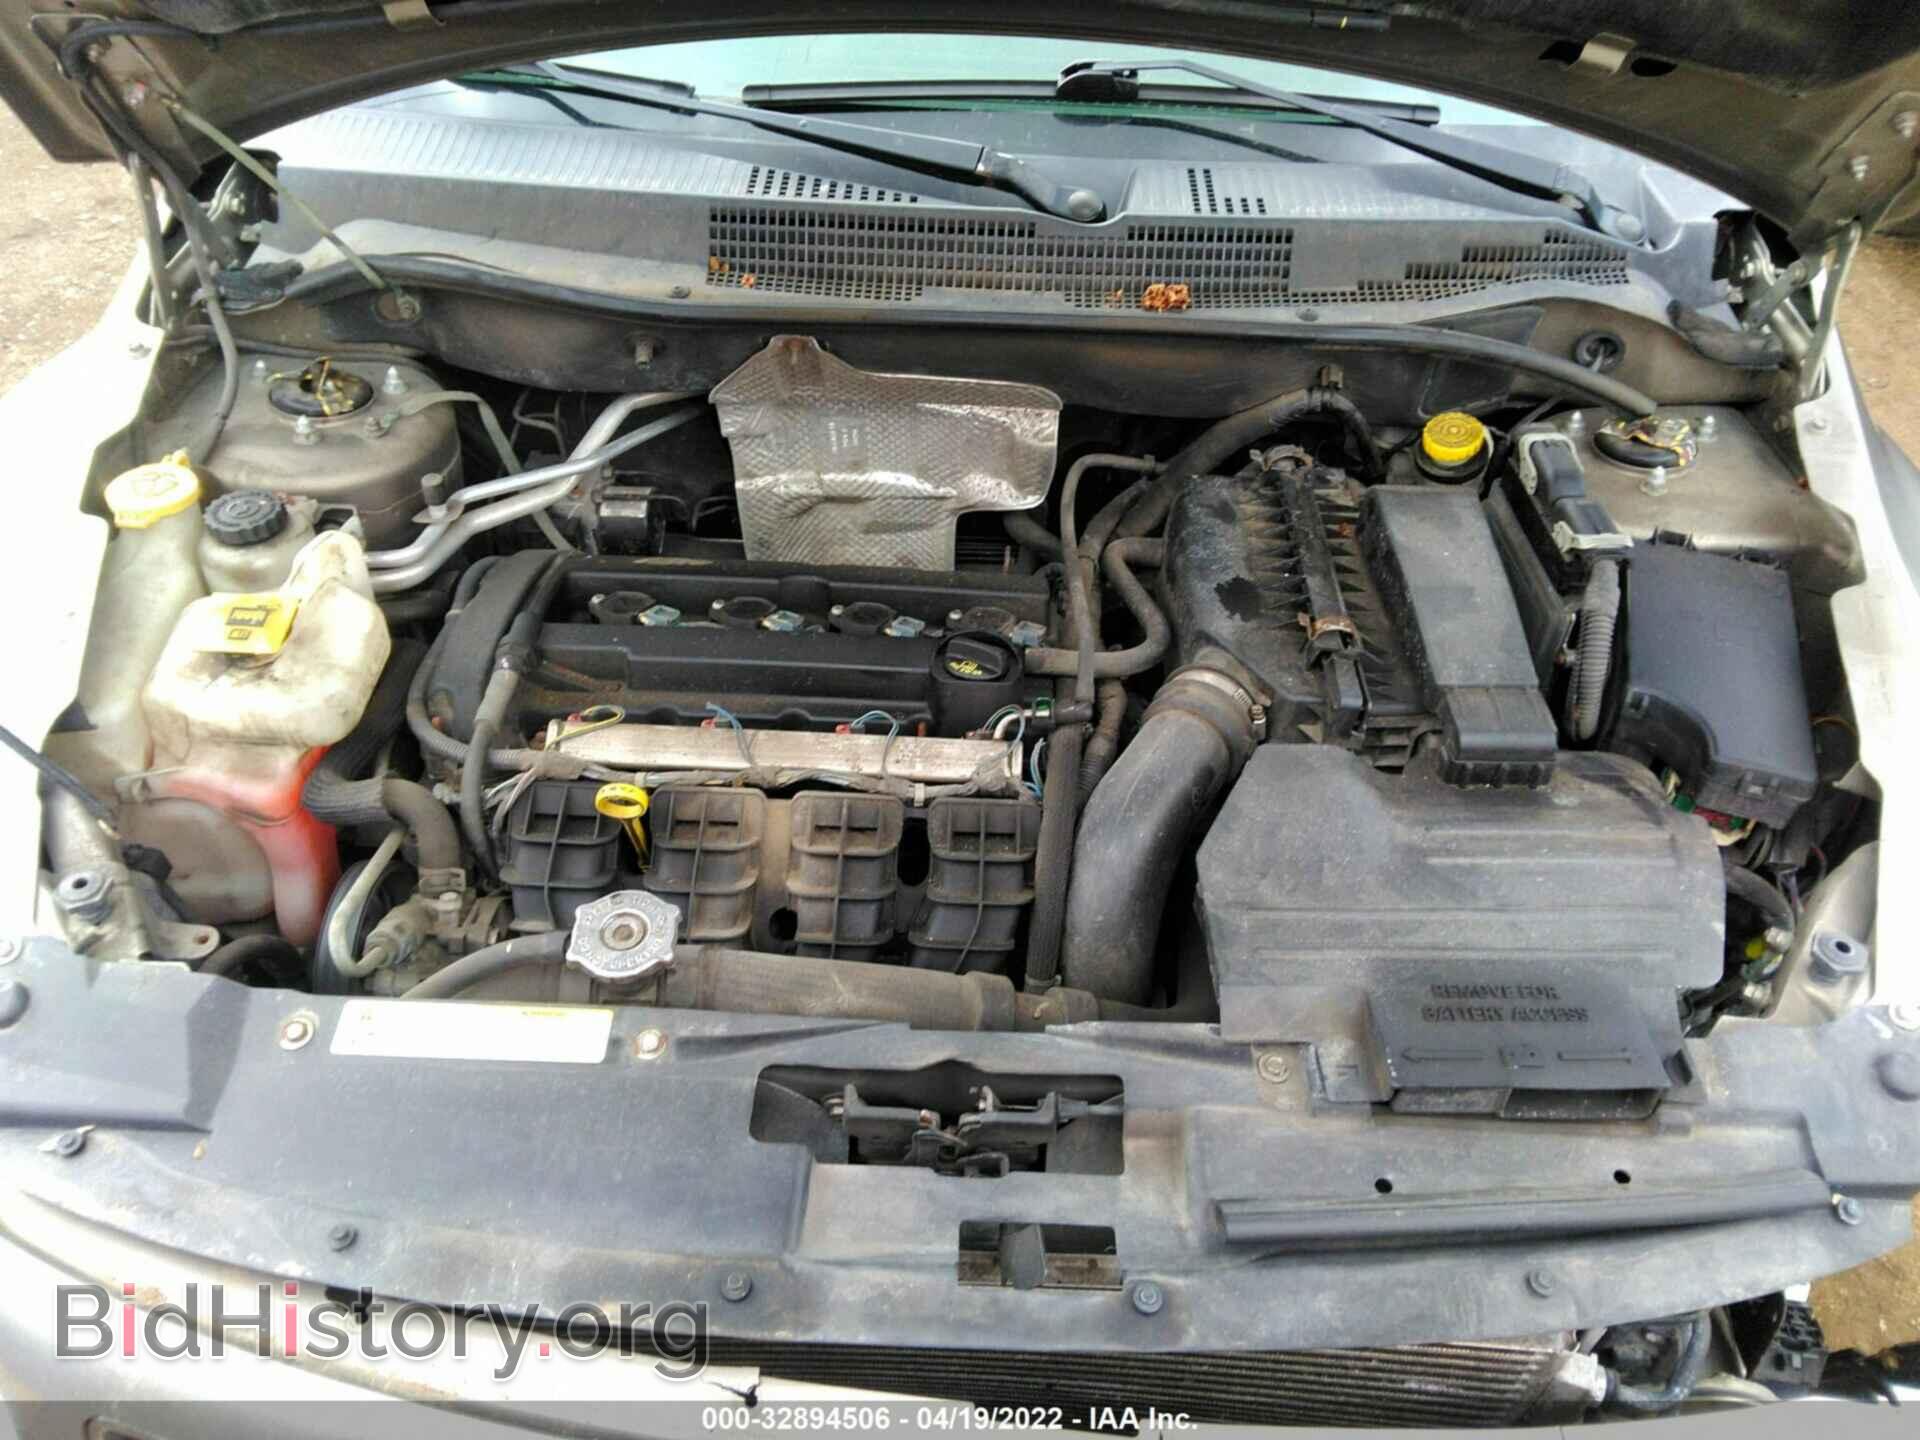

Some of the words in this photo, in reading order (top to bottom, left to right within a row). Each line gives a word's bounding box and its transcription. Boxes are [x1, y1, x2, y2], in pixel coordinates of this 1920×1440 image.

[1430, 983, 1513, 1000] REMOVE
[1518, 984, 1561, 1000] FOR
[1511, 1006, 1590, 1023] ACCESS
